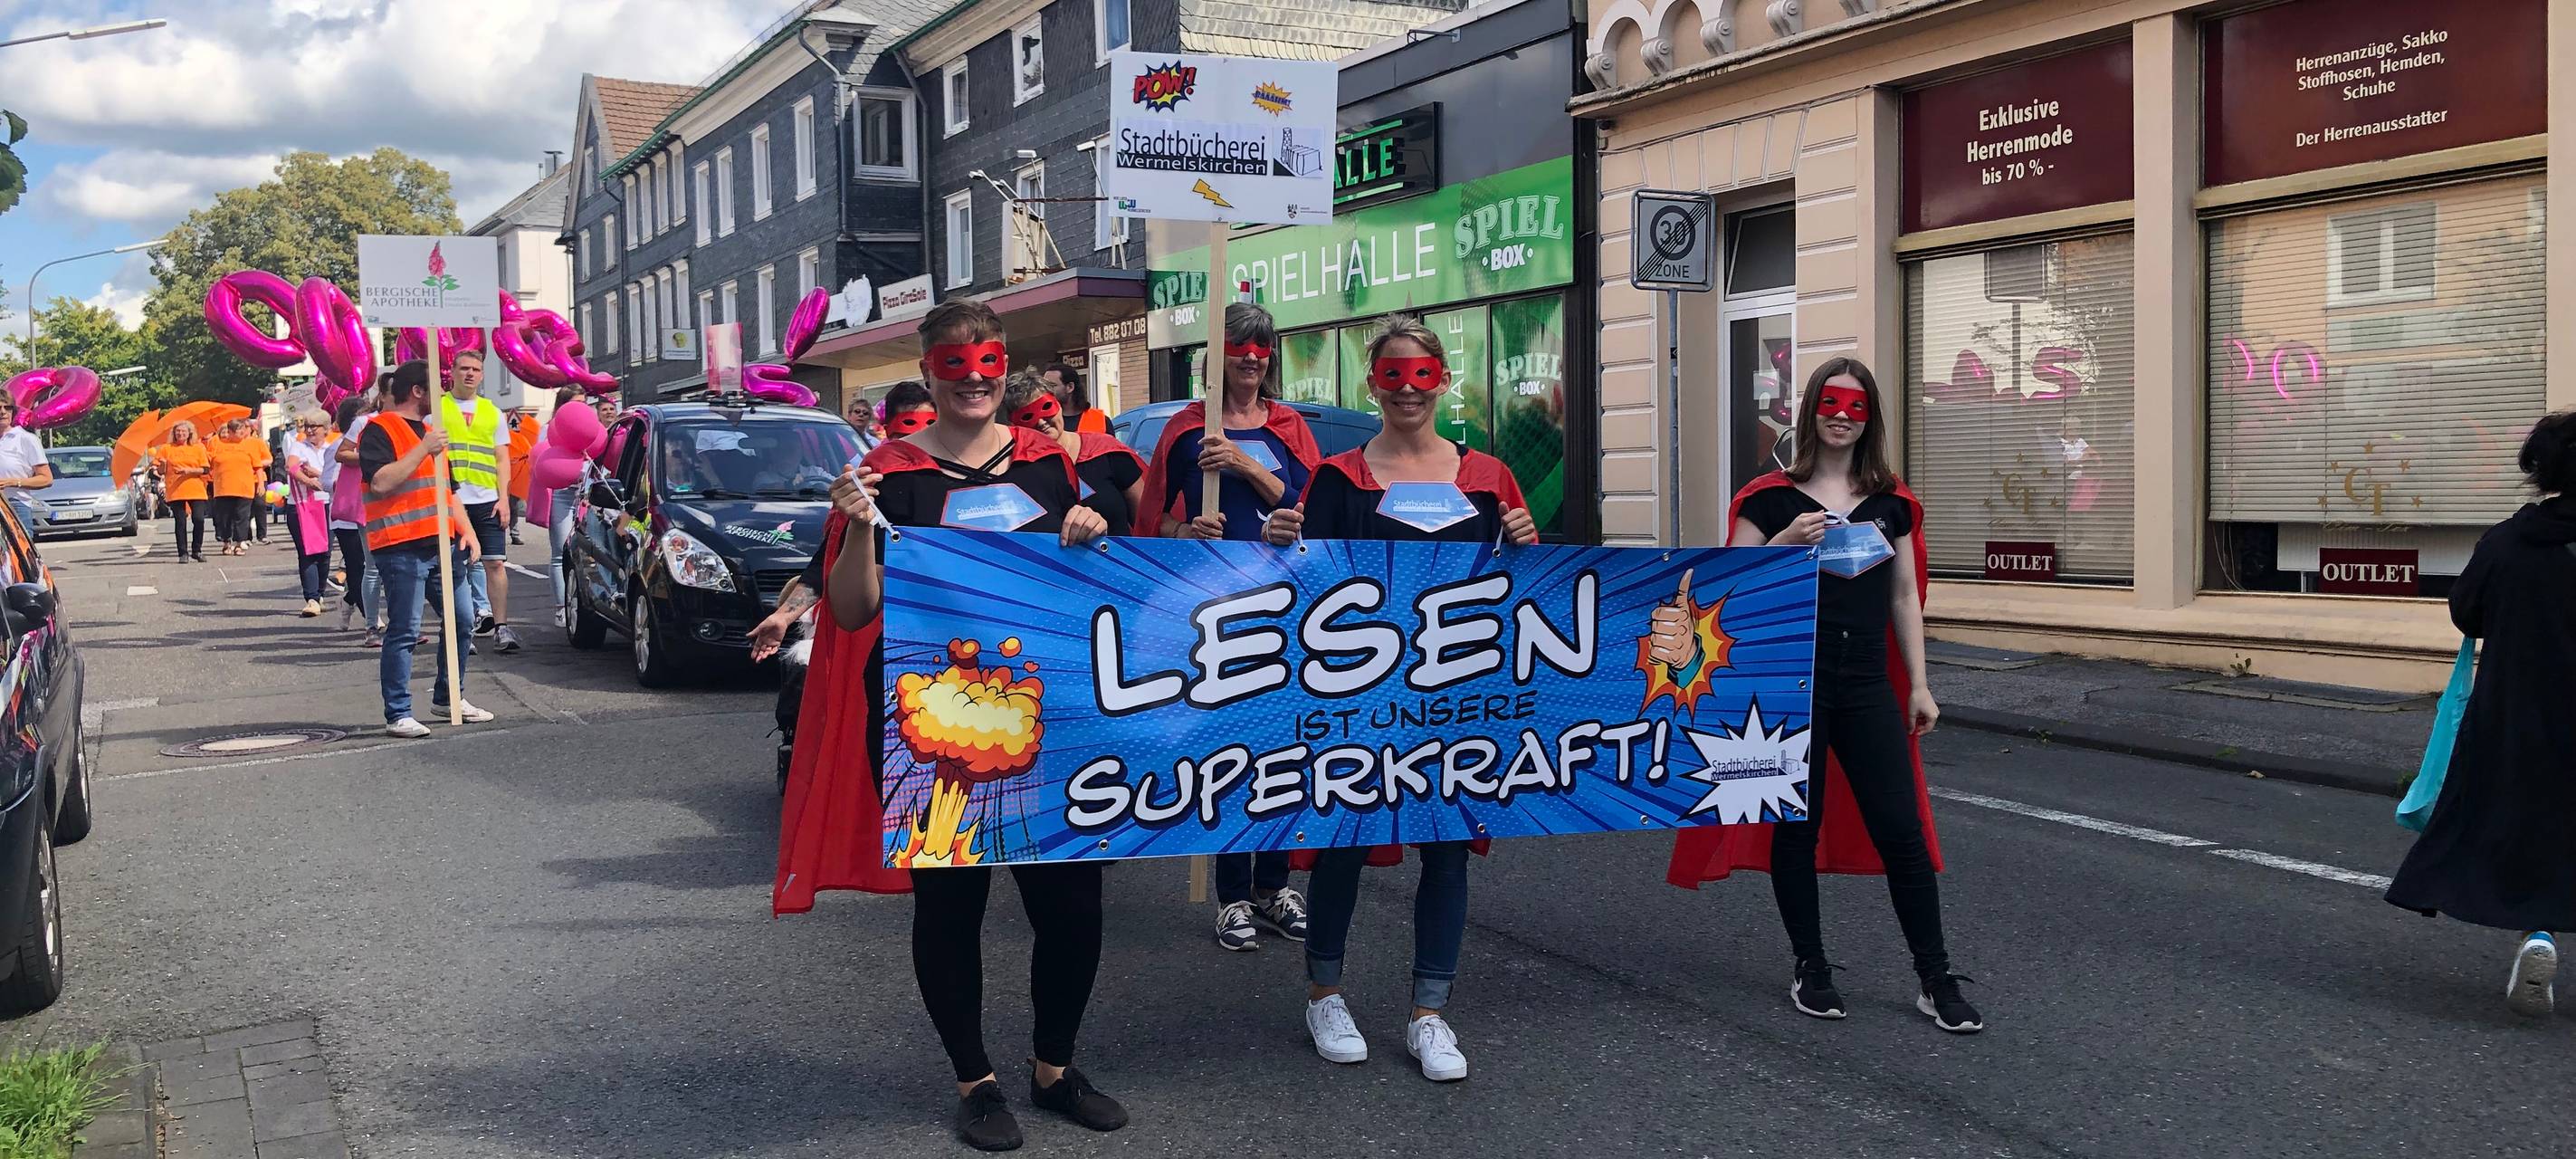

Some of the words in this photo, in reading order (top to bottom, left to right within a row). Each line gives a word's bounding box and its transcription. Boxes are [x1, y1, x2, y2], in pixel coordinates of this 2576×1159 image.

[2295, 42, 2398, 72] Herrenanzüge,
[2401, 29, 2448, 50] Sakko
[1132, 66, 1197, 104] POW!
[2297, 65, 2376, 91] Stoffhosen,
[2380, 52, 2446, 74] Hemden,
[2342, 80, 2396, 101] Schuhe
[1979, 98, 2059, 131] Exklusive
[2295, 131, 2320, 148] Der
[2323, 110, 2448, 143] Herrenausstatter
[1121, 127, 1265, 160] Stadtbücherei
[1966, 124, 2073, 163] Herrenmode
[1117, 151, 1266, 175] Wermelskirchen
[1982, 167, 2002, 186] bis
[2006, 162, 2025, 181] 70
[2028, 158, 2044, 177] %
[1453, 194, 1565, 259] SPIEL
[1659, 220, 1686, 245] 30
[1655, 264, 1690, 278] ZONE
[366, 286, 438, 297] BERGISCHE
[370, 297, 439, 308] APOTHEKE
[1090, 327, 1102, 343] Tel.
[1103, 322, 1120, 340] 882
[1121, 320, 1132, 338] 07
[1133, 317, 1146, 335] 08
[1495, 352, 1563, 386] SPIEL
[1987, 553, 2053, 570] OUTLET
[2323, 562, 2416, 583] OUTLET
[1091, 568, 1600, 717] LESEN
[1294, 707, 1363, 742] IST
[1369, 690, 1541, 732] UNSERE
[1065, 720, 1671, 830] SUPERKRAFT!
[1712, 755, 1776, 772] Stadtbücherei
